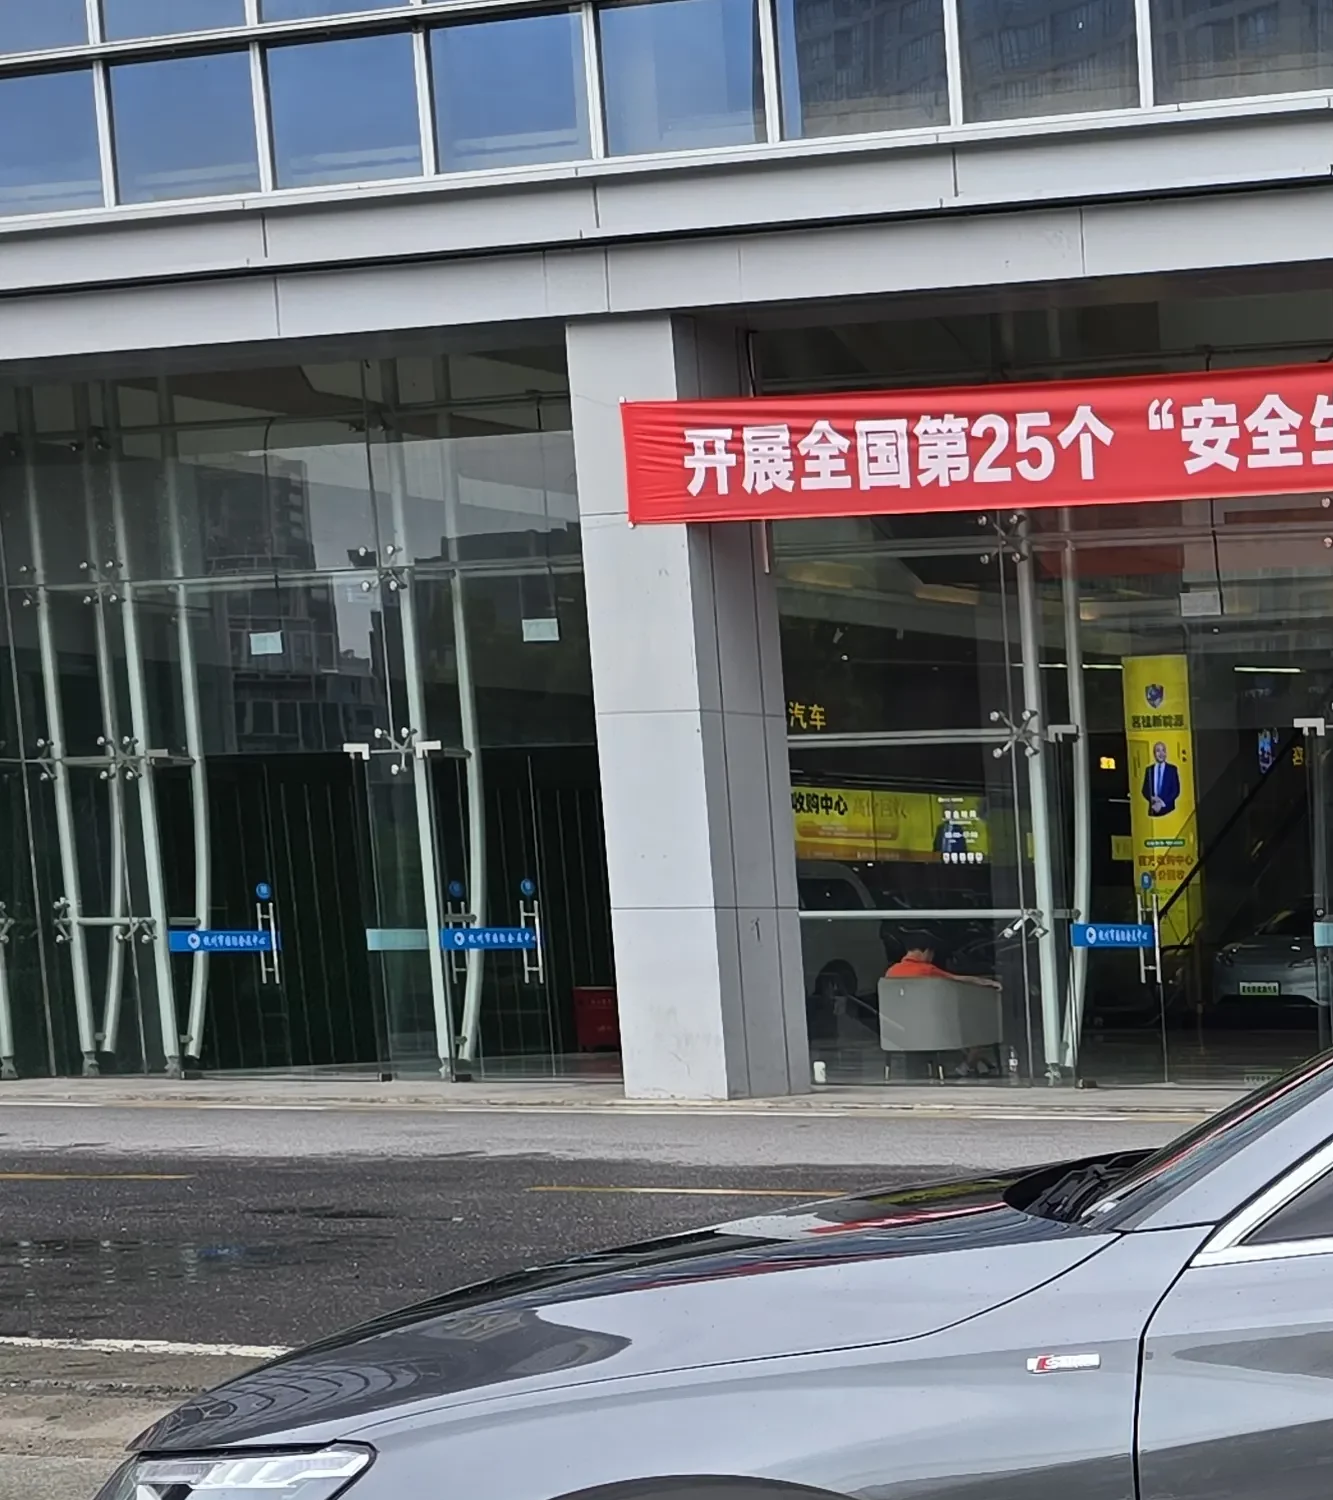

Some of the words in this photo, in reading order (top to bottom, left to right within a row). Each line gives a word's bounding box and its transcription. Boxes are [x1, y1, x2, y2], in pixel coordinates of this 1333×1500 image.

[684, 405, 1115, 496] 开展全国第25个
